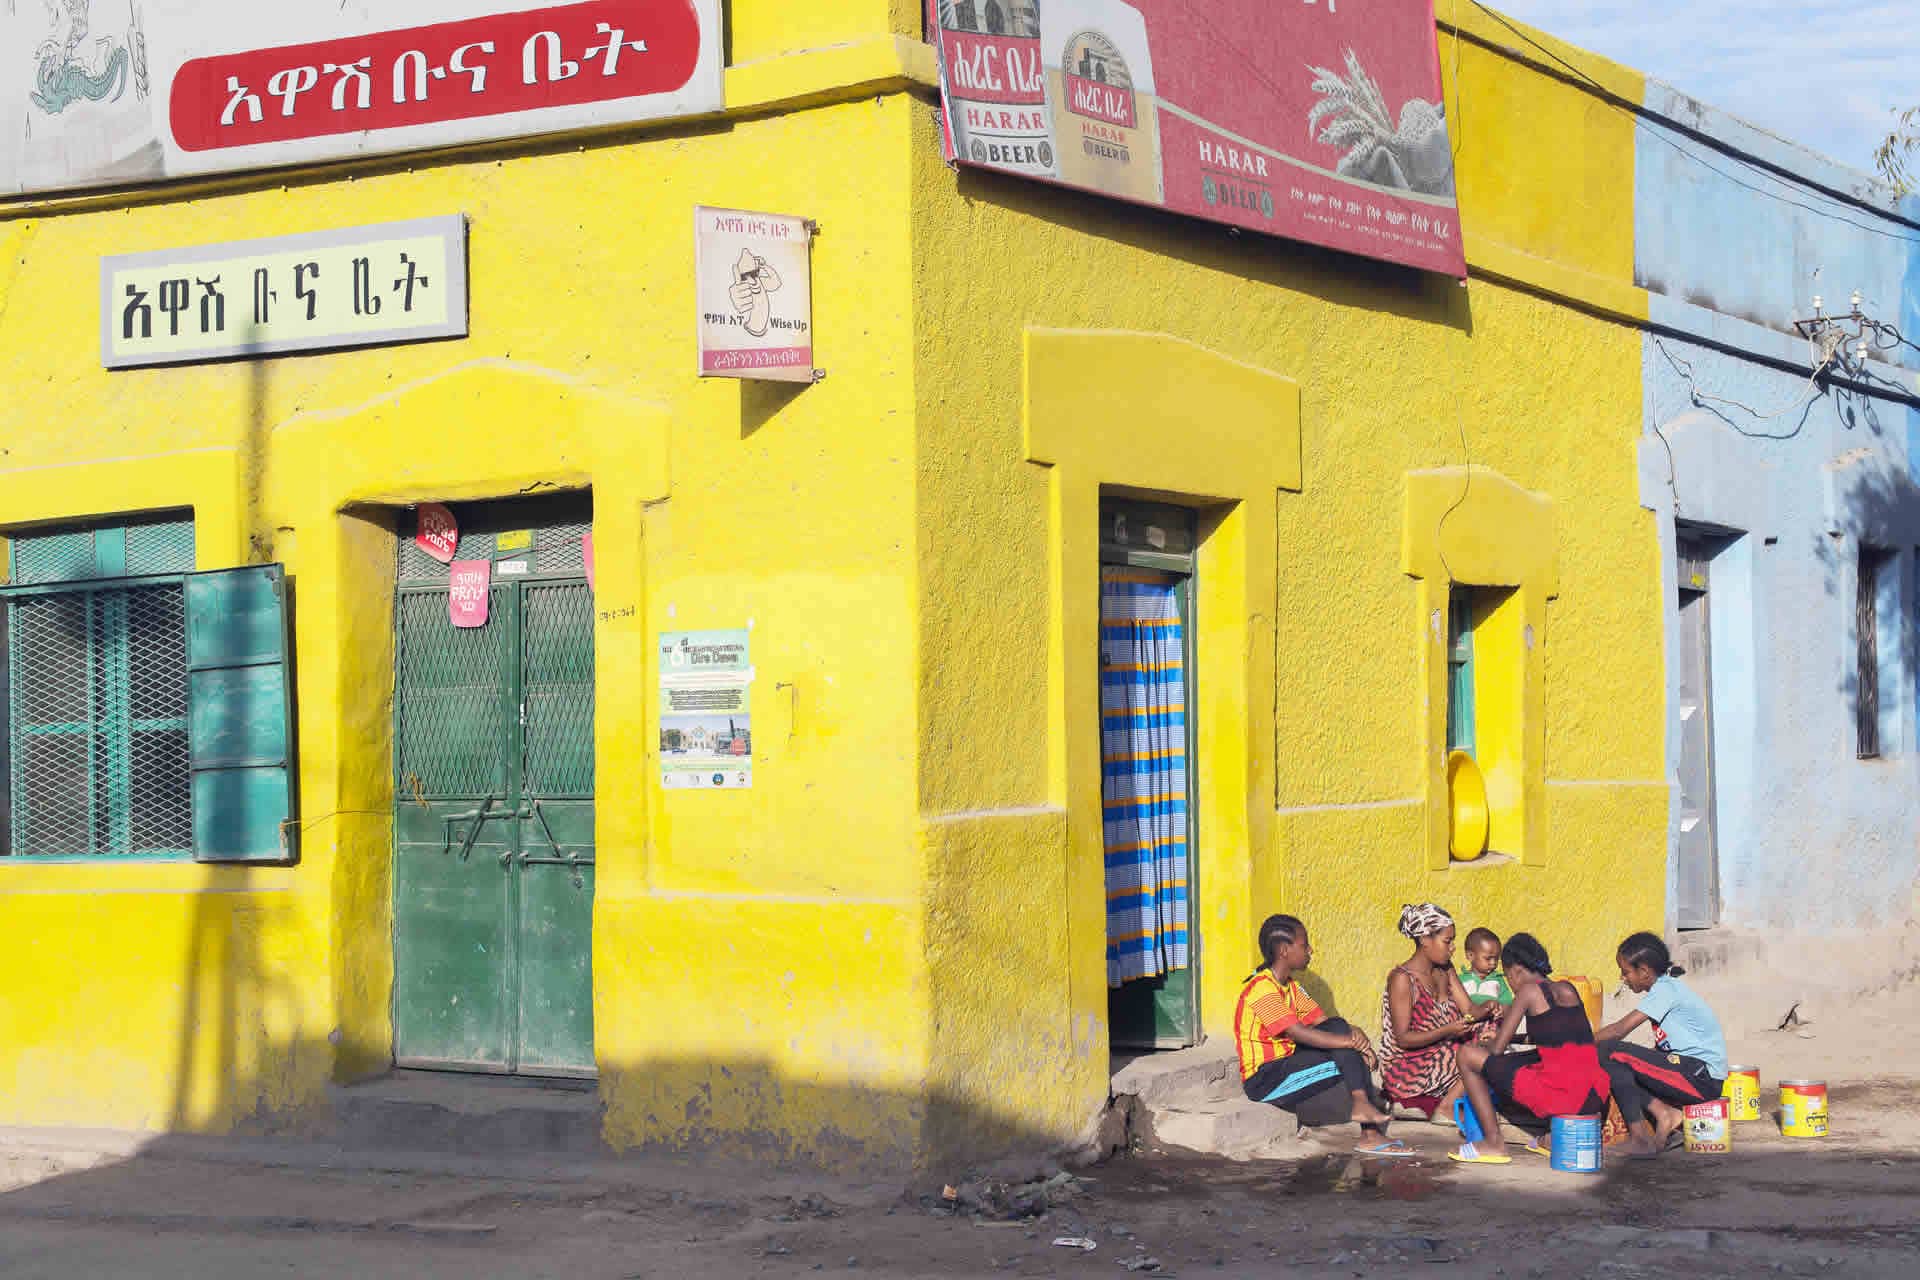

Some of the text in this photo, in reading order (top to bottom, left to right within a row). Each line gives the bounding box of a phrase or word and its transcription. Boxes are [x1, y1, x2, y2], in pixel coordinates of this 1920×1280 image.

[220, 22, 648, 126] አዋሽ ቡና ቤት
[967, 108, 1045, 130] HARAR
[1081, 121, 1126, 143] HARAR
[988, 143, 1037, 163] BEER
[1200, 140, 1269, 177] HARAR
[123, 274, 225, 338] አዋሽ
[352, 252, 429, 315] ቤት
[770, 317, 807, 333] Wise Up
